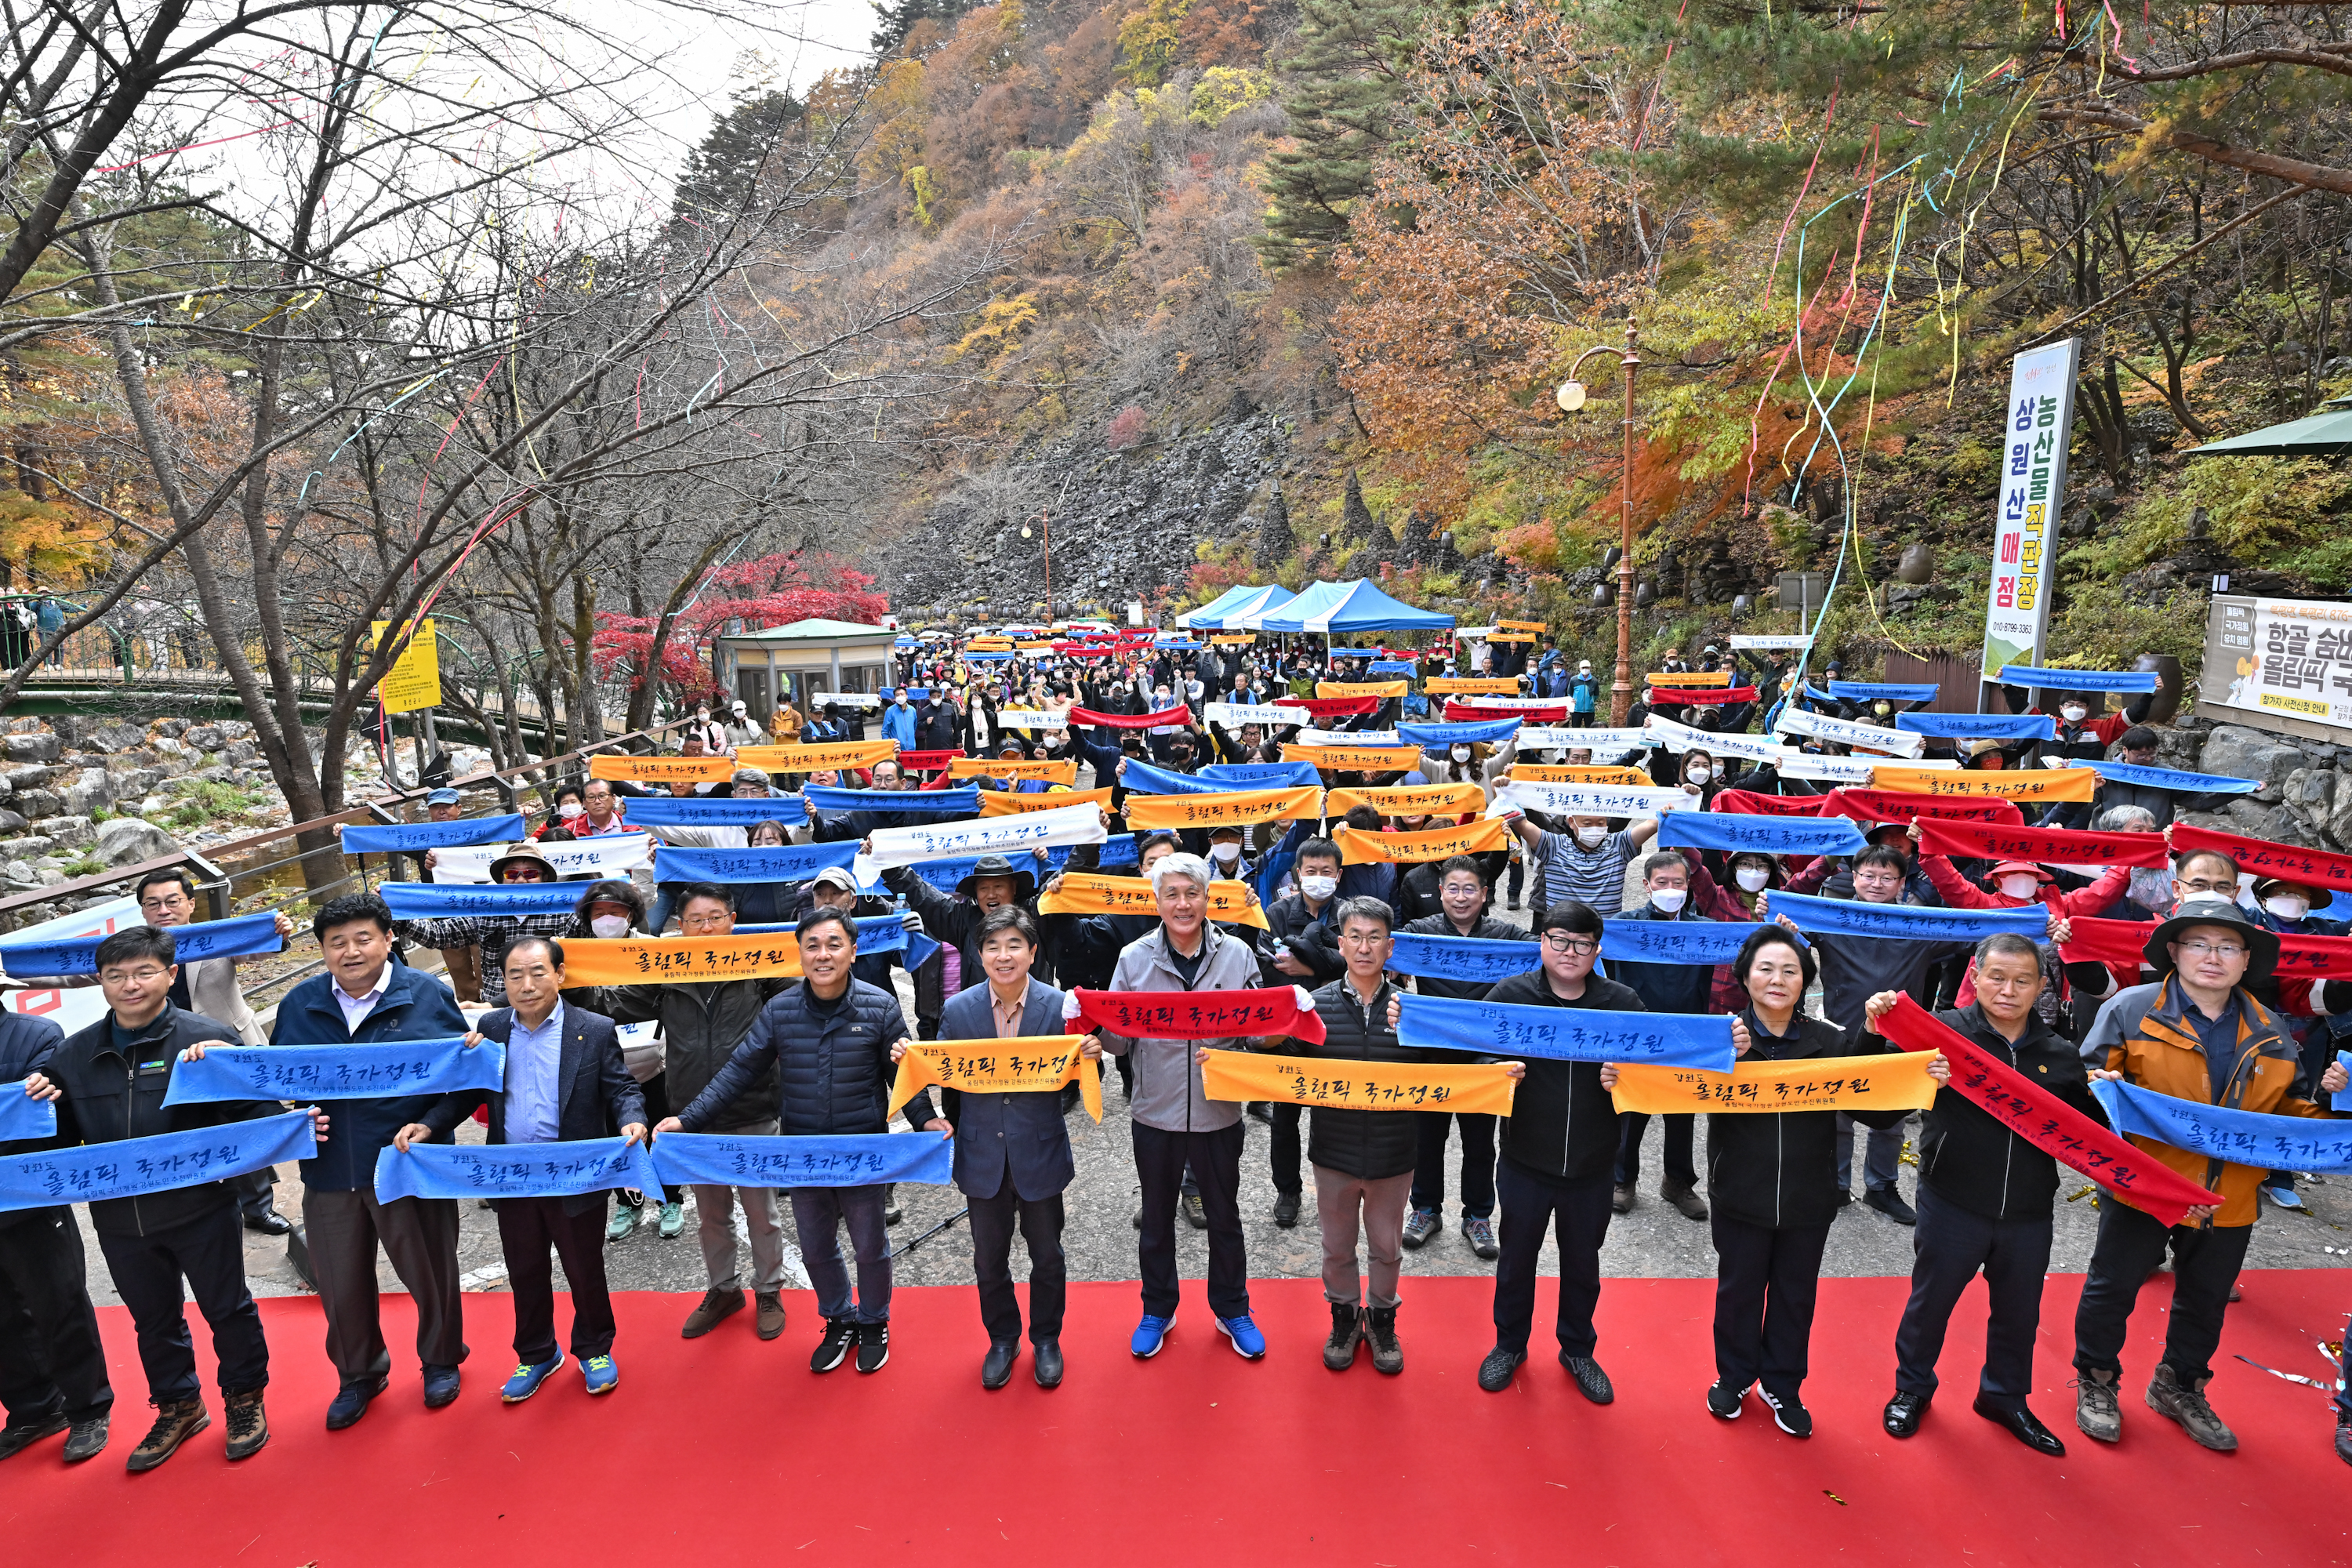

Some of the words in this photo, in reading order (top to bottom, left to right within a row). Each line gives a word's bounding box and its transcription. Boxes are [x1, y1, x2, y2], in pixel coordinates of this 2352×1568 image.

[2227, 607, 2245, 618] 올림픽
[2270, 605, 2297, 618] 북평면
[2299, 607, 2327, 621] 북평리
[1993, 622, 2032, 634] 010-8799-3363
[2225, 620, 2249, 632] 국가정원
[2223, 634, 2236, 644] 유치
[2267, 622, 2310, 657] 항골
[2044, 676, 2074, 687] 올림픽
[2081, 677, 2125, 688] 국가정원
[2263, 655, 2329, 693] 올림픽
[2263, 695, 2282, 706] 참가자
[2283, 699, 2310, 712] 사전신청
[2312, 703, 2325, 715] 안내
[1809, 720, 1844, 734] 올림픽
[1850, 727, 1895, 745] 국가정원
[1938, 720, 1968, 731] 올림픽
[1973, 721, 2018, 731] 국가정원
[1546, 734, 1574, 742] 올림픽
[1686, 730, 1717, 745] 올림픽
[1725, 740, 1766, 755] 국가정원
[781, 754, 814, 768] 올림픽
[819, 753, 864, 763] 국가정원
[1321, 753, 1348, 764] 올림픽
[1353, 754, 1392, 764] 국가정원
[630, 765, 660, 775] 올림픽
[666, 765, 709, 775] 국가정원
[2122, 764, 2155, 778] 올림픽
[2162, 772, 2215, 788] 국가정원
[1929, 781, 1971, 795] 올림픽
[1982, 783, 2045, 795] 국가정원
[1364, 795, 1398, 806] 올림픽
[1406, 793, 1455, 805] 국가정원
[1544, 792, 1584, 808] 올림픽
[1594, 794, 1650, 809] 국가정원
[1185, 804, 1223, 822] 올림픽
[1232, 801, 1287, 817] 국가정원
[1874, 798, 1919, 815] 올림픽
[1929, 806, 1997, 822] 국가정원
[1714, 817, 1734, 826] 강원도
[397, 834, 430, 847] 올림픽
[438, 829, 488, 842] 국가정원
[922, 834, 970, 853] 올림픽
[982, 825, 1049, 844] 국가정원
[1725, 826, 1770, 843] 올림픽
[1780, 831, 1847, 847] 국가정원
[1383, 844, 1414, 858] 올림픽
[1422, 840, 1472, 856] 국가정원
[1984, 839, 2032, 855] 올림픽
[2045, 841, 2117, 858] 국가정원
[709, 858, 750, 874] 올림픽
[759, 858, 818, 869] 국가정원
[1090, 881, 1112, 891] 강원도
[447, 894, 494, 908] 올림픽
[506, 894, 575, 907] 국가정원
[1102, 891, 1149, 906] 올림픽
[1837, 910, 1888, 927] 올림픽
[1902, 916, 1980, 931] 국가정원
[635, 950, 691, 972] 올림픽
[705, 950, 784, 966] 국가정원
[1419, 946, 1471, 967] 올림픽
[1483, 950, 1540, 971] 국가정
[1116, 1007, 1174, 1026] 올림픽
[1189, 1006, 1273, 1028] 국가정원
[1478, 1007, 1508, 1019] 강원도
[1494, 1021, 1558, 1047] 올림픽
[1572, 1027, 1664, 1054] 국가정원
[230, 1054, 265, 1063] 강원도
[920, 1047, 949, 1056] 강원도
[938, 1056, 996, 1080] 올림픽
[1276, 1065, 1305, 1075] 강원도
[1963, 1053, 1991, 1074] 강원도
[250, 1064, 320, 1088] 올림픽
[336, 1062, 430, 1082] 국가정원
[1674, 1073, 1706, 1083] 강원도
[1290, 1076, 1351, 1102] 올림픽
[1364, 1082, 1452, 1104] 국가정원
[1693, 1083, 1759, 1102] 올림픽
[1774, 1078, 1871, 1096] 국가정원
[2169, 1107, 2200, 1123] 강원도
[1965, 1073, 2033, 1118] 올림픽
[2040, 1120, 2137, 1189] 국가정원
[2187, 1123, 2258, 1156] 올림픽
[717, 1142, 744, 1151] 강원도
[19, 1162, 56, 1173] 강원도
[450, 1155, 480, 1163] 강원도
[731, 1152, 789, 1173] 올림픽
[803, 1152, 884, 1173] 국가정원
[43, 1163, 119, 1196] 올림픽
[136, 1145, 241, 1179] 국가정원
[468, 1162, 530, 1187] 올림픽
[546, 1156, 630, 1179] 국가정원
